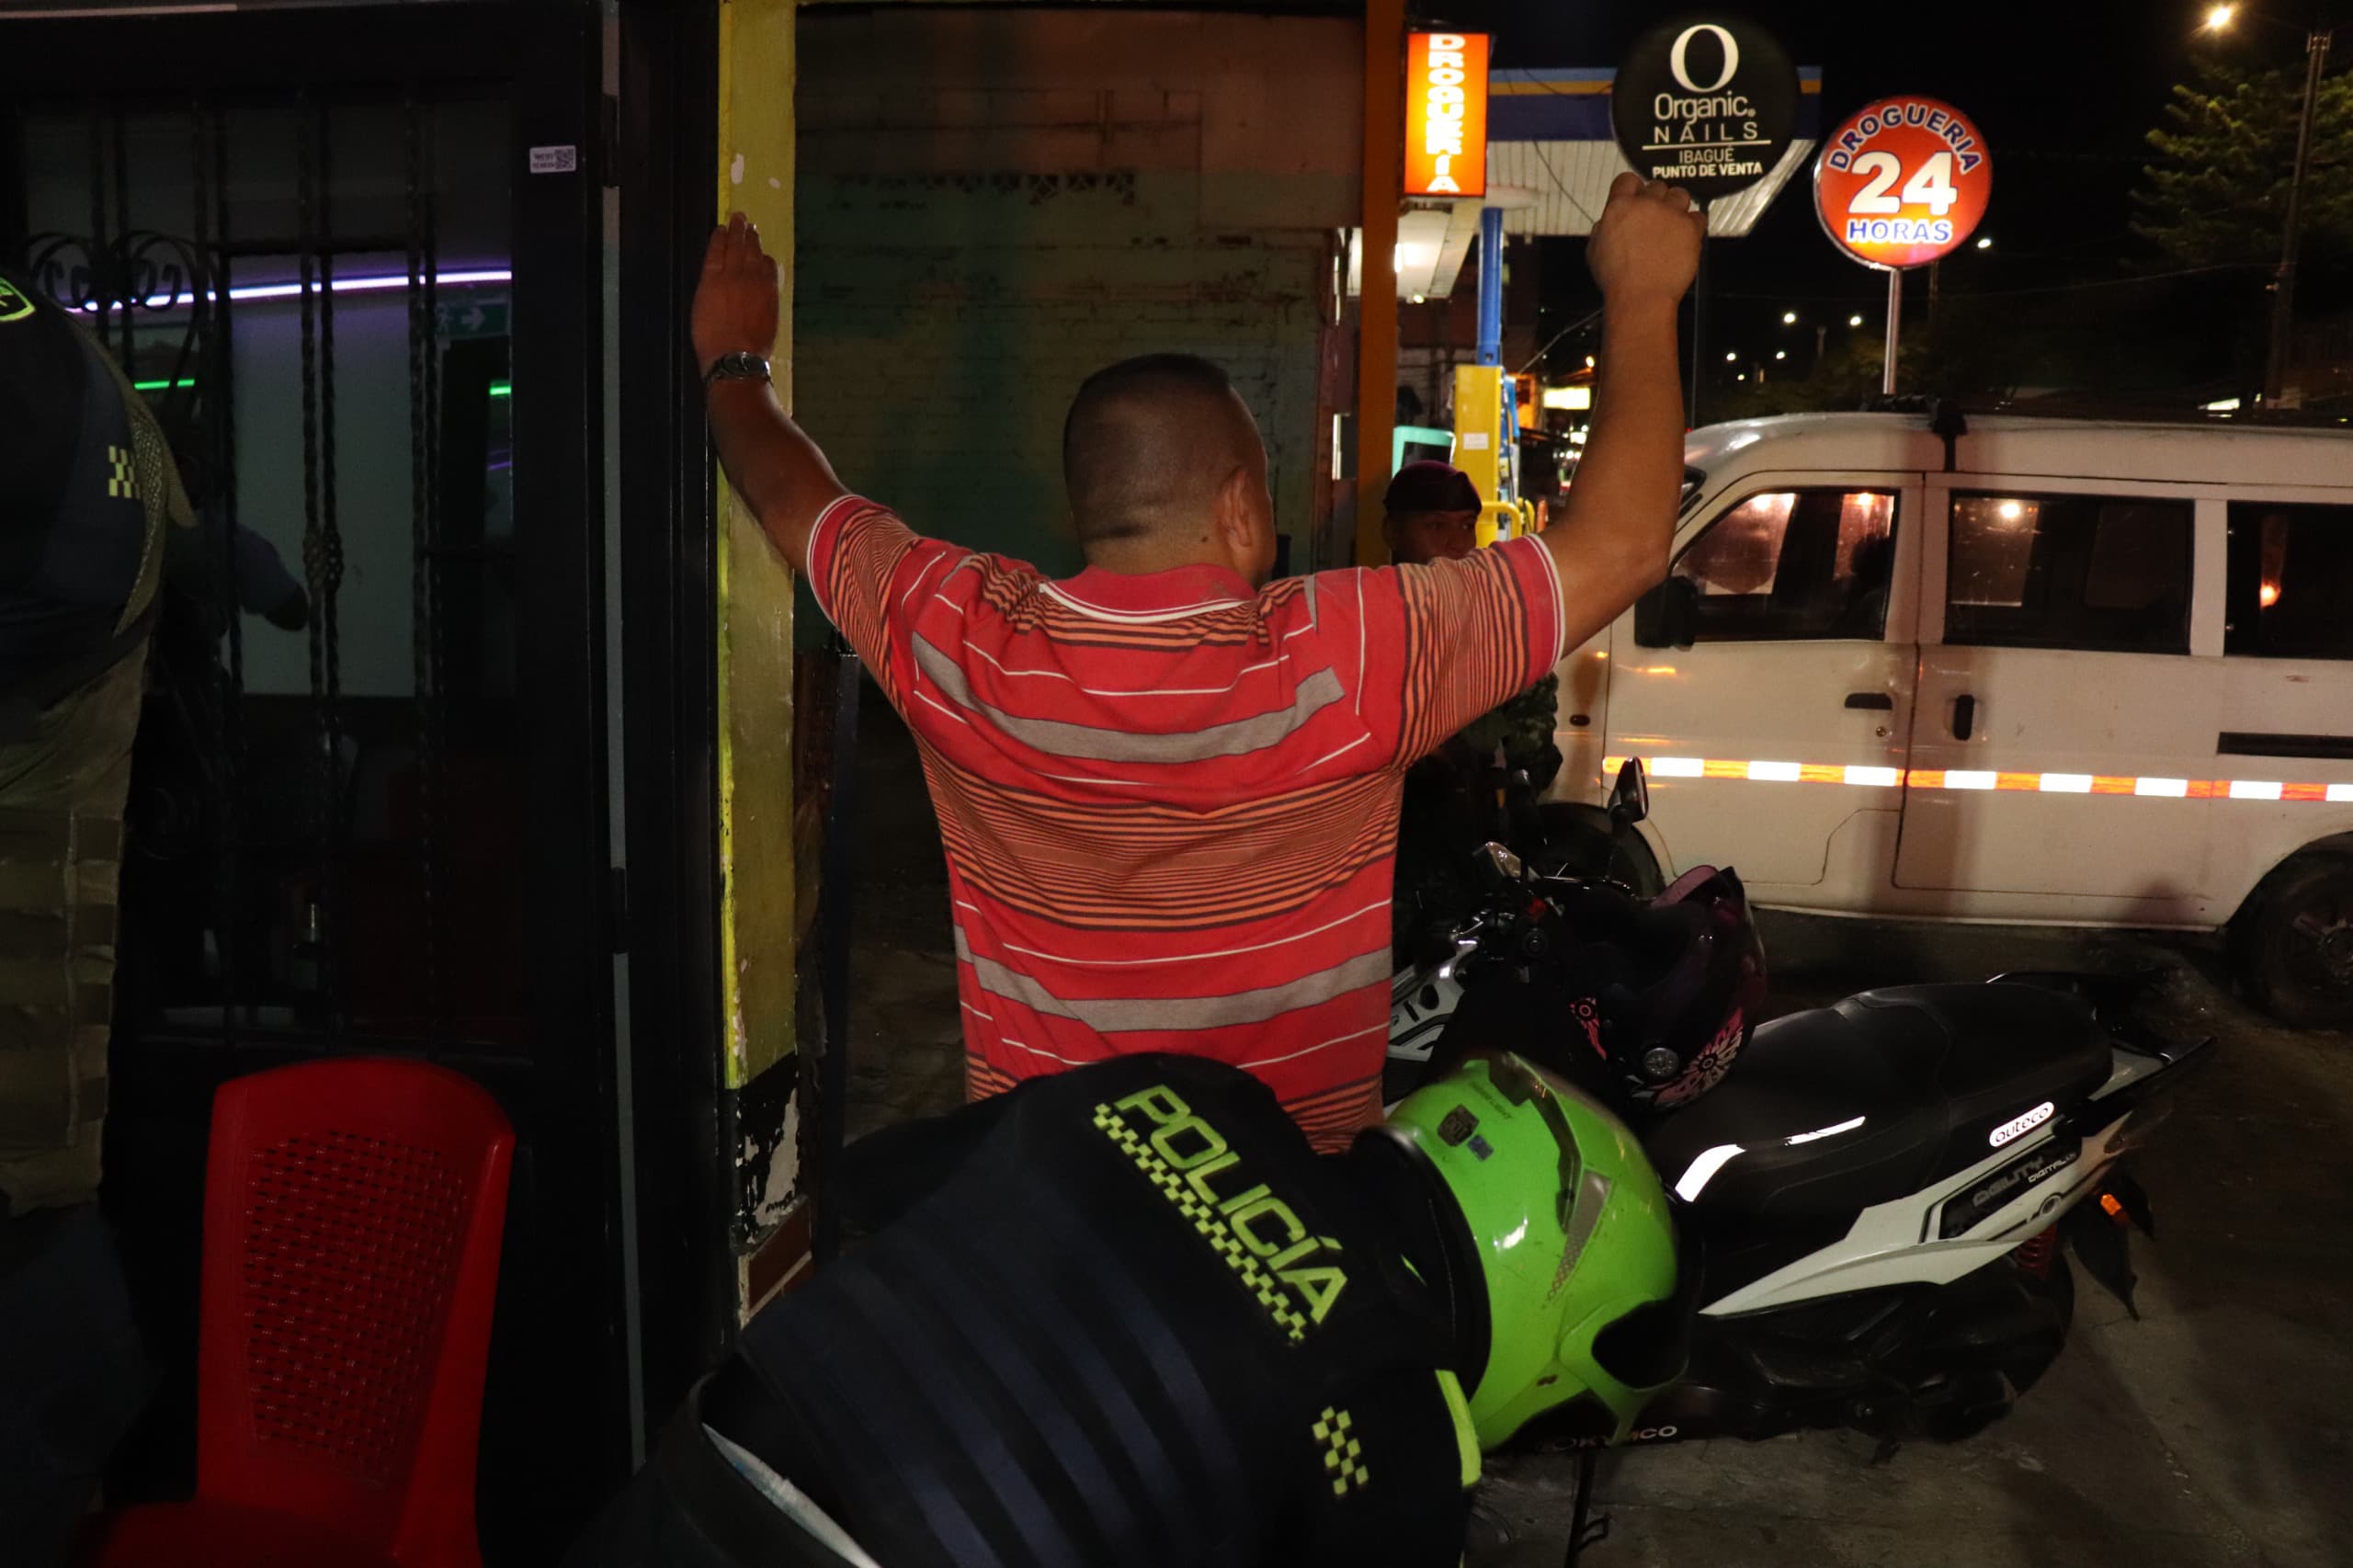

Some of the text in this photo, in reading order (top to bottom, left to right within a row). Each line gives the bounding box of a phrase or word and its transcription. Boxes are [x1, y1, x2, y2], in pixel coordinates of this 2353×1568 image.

[1670, 23, 1739, 93] O
[1654, 121, 1758, 143] NAILS
[1829, 103, 1982, 174] DROGUERIA
[1652, 161, 1763, 179] PUNTO DE VENTA
[1678, 145, 1734, 165] IBAGUÉ
[1847, 151, 1958, 216] 24
[1848, 219, 1950, 243] HORAS
[1995, 1108, 2050, 1142] auteco
[1112, 1083, 1348, 1325] POLICÍA
